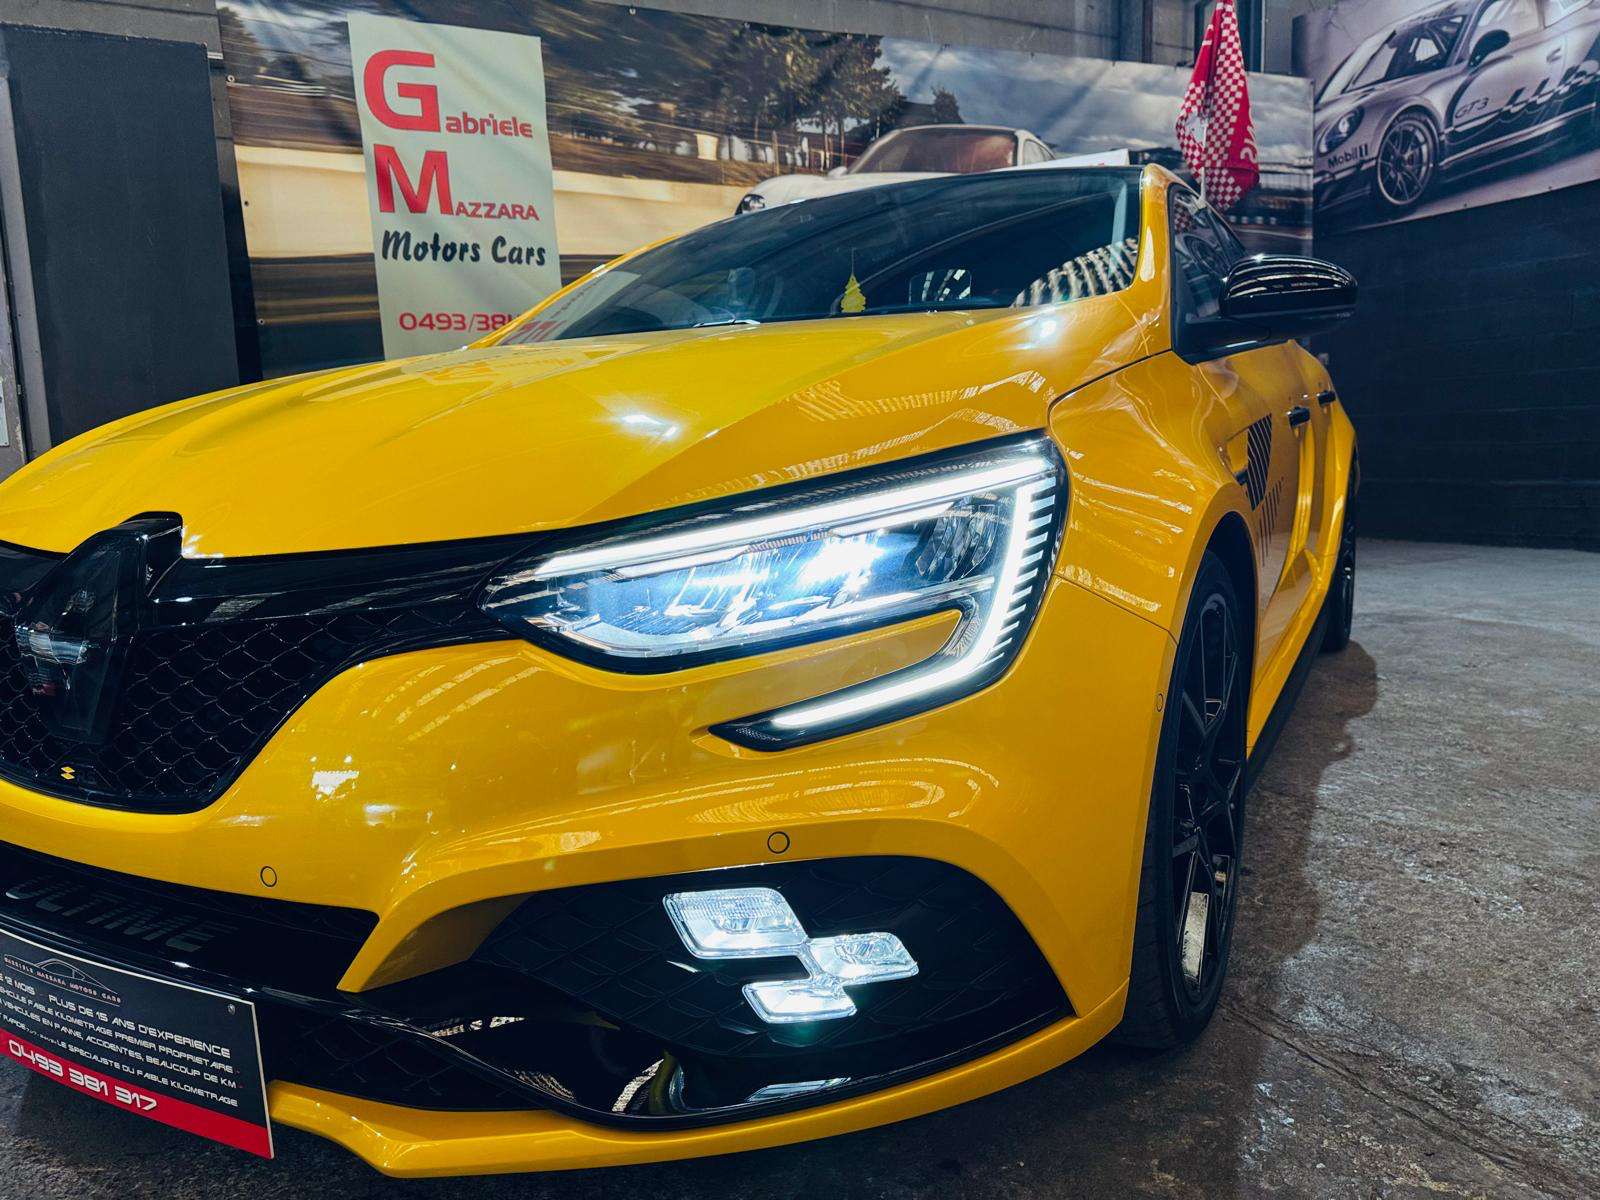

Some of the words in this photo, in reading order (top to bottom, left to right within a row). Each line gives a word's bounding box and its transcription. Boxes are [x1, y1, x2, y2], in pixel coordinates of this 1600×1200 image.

[363, 49, 533, 138] Gabriele
[1455, 96, 1489, 119] GT3
[373, 143, 540, 221] MAZZARA
[381, 230, 481, 263] Motors
[491, 235, 547, 266] Cars
[48, 994, 77, 1012] PLUS
[78, 1005, 94, 1018] DE
[96, 1011, 109, 1023] 15
[112, 1018, 136, 1031] ANS
[138, 1024, 232, 1060] D'EXPERIENCE
[115, 1031, 157, 1051] PREMIER
[9, 1039, 64, 1078] 0493
[68, 1067, 109, 1096] 381
[115, 1085, 158, 1112] 317
[122, 1065, 135, 1074] DU
[170, 1080, 239, 1108] KILOMETRAGE
[146, 1055, 201, 1077] BEAUCOUP
[204, 1072, 219, 1083] DE
[220, 1077, 237, 1089] KM
